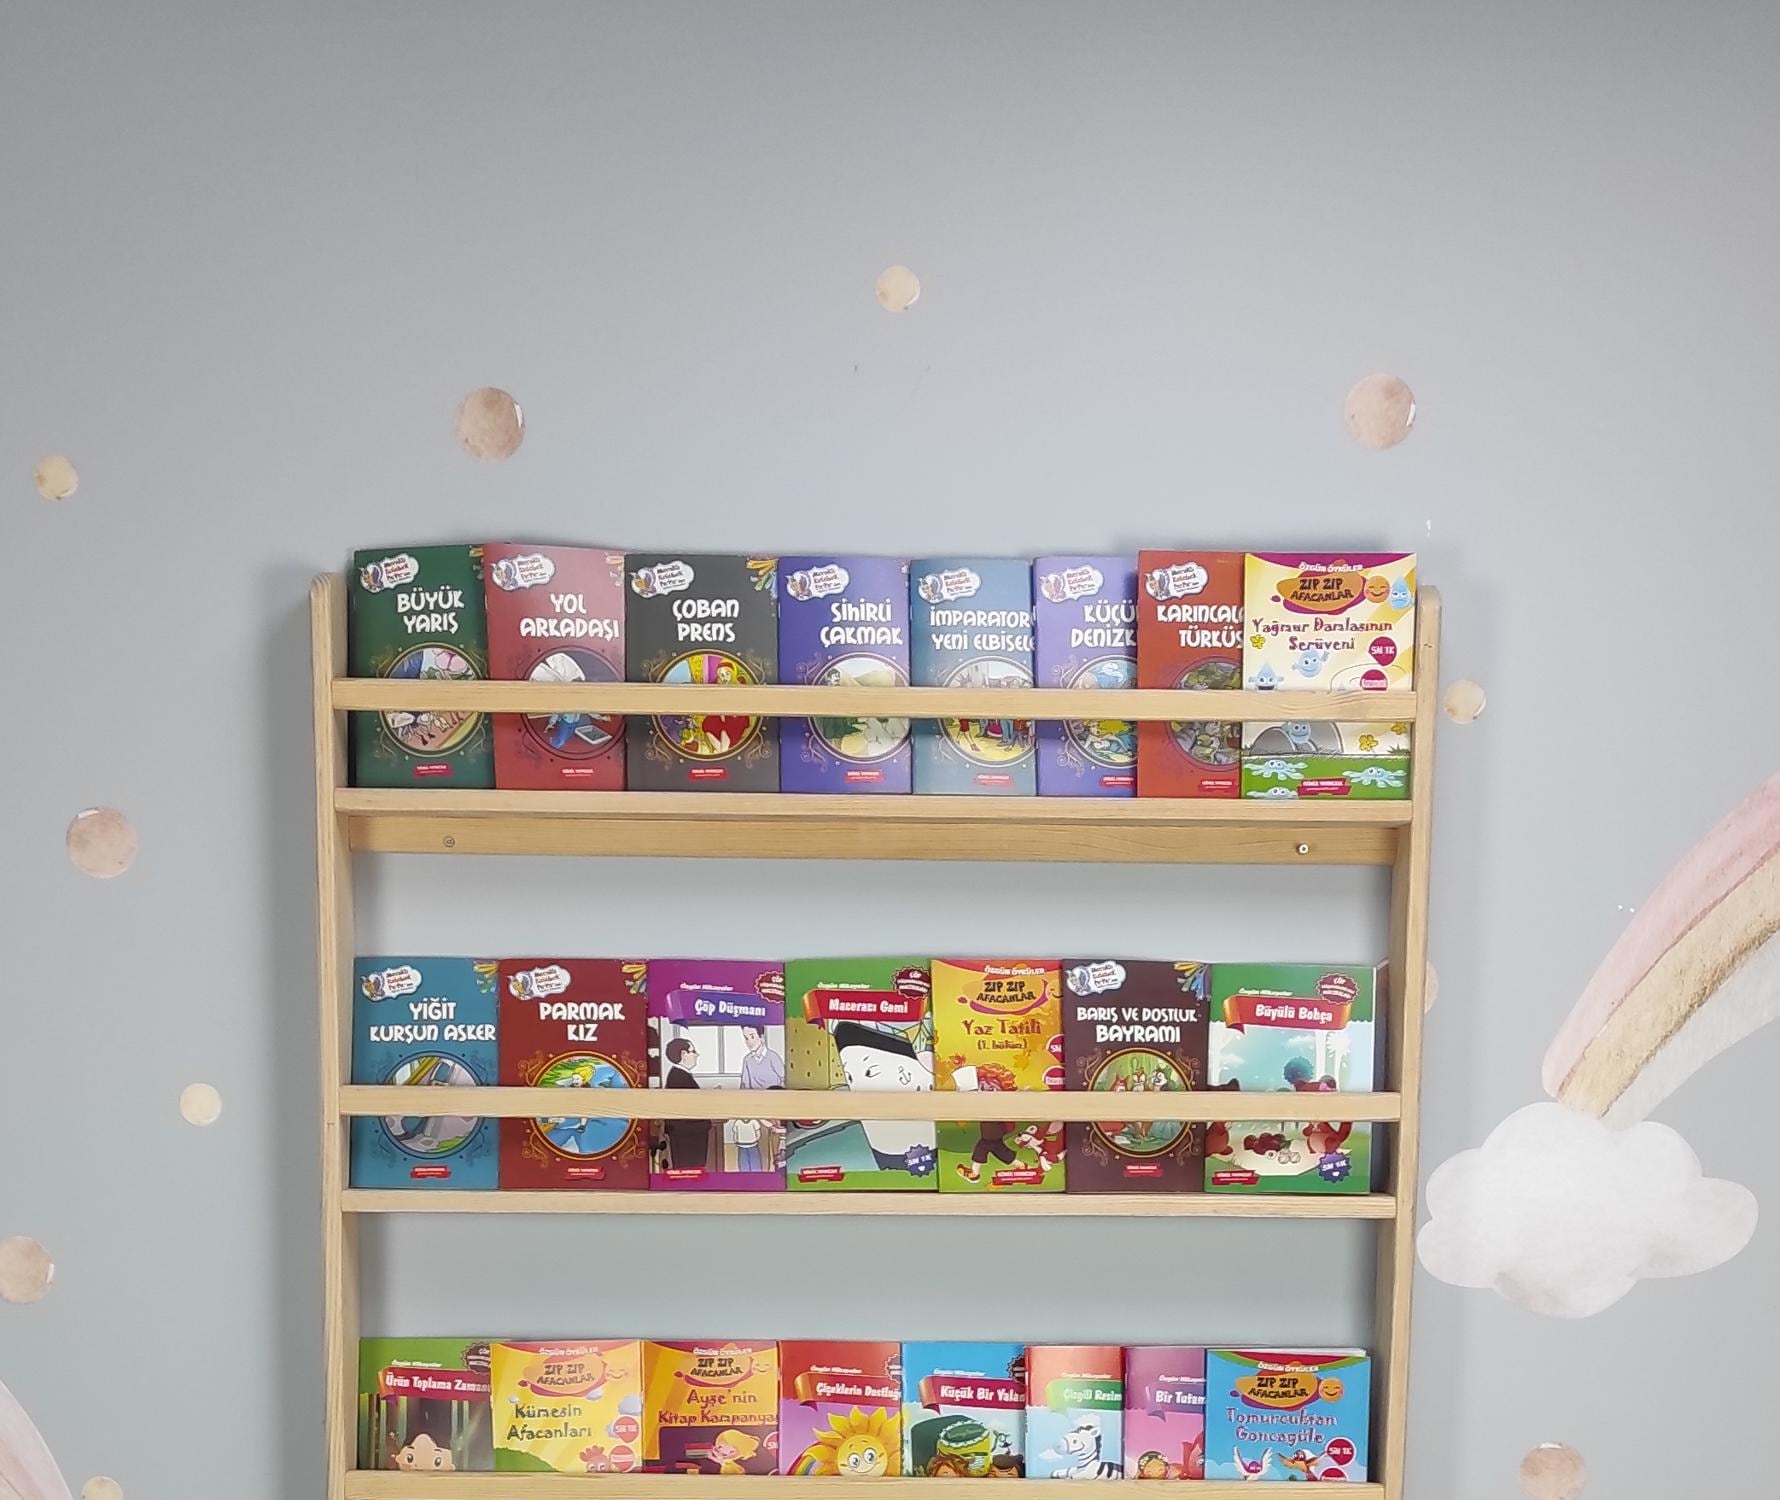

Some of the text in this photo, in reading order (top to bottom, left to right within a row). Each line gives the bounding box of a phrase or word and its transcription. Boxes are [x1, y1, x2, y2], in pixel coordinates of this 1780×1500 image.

[1300, 578, 1342, 590] ZIP ZIP
[397, 586, 464, 612] BÜYÜK
[550, 594, 587, 614] YOL
[672, 599, 740, 621] ÇOBAN
[403, 612, 458, 634] YARIŞ
[520, 618, 620, 641] ARKADAŞI
[1251, 618, 1309, 636] Yağmur
[678, 623, 736, 642] PRENS
[820, 626, 904, 648] ÇAKMAK
[932, 631, 967, 650] YENİ
[1289, 636, 1354, 650] Serüveni
[984, 981, 1025, 992] ZIP ZIP
[409, 998, 456, 1020] YİĞİT
[539, 1002, 625, 1020] PARMAK
[695, 1000, 766, 1016] Çöp Düşmanı
[829, 1000, 908, 1013] Maceracı Gemi
[1077, 1008, 1197, 1022] BARIŞ VE DOSTLUK
[1256, 1004, 1332, 1024] Büyülü Bohça
[370, 1024, 496, 1045] KURŞUN ASKER
[567, 1024, 598, 1041] KIZ
[962, 1019, 1041, 1035] Yaz Tatili
[1096, 1025, 1180, 1043] BAYRAMI
[545, 1364, 584, 1376] ZIP ZIP
[698, 1358, 734, 1368] ZIP ZIP
[386, 1372, 409, 1387] Ürün
[412, 1376, 451, 1390] Toplama
[816, 1382, 862, 1397] Çiçeklerin
[1257, 1378, 1298, 1388] ZIP ZIP
[940, 1385, 974, 1400] Küçük
[977, 1387, 994, 1400] Bir
[1156, 1391, 1172, 1403] Bir
[515, 1404, 582, 1419] Kümesin
[658, 1410, 698, 1426] Kitap
[507, 1424, 592, 1441] Afacanları
